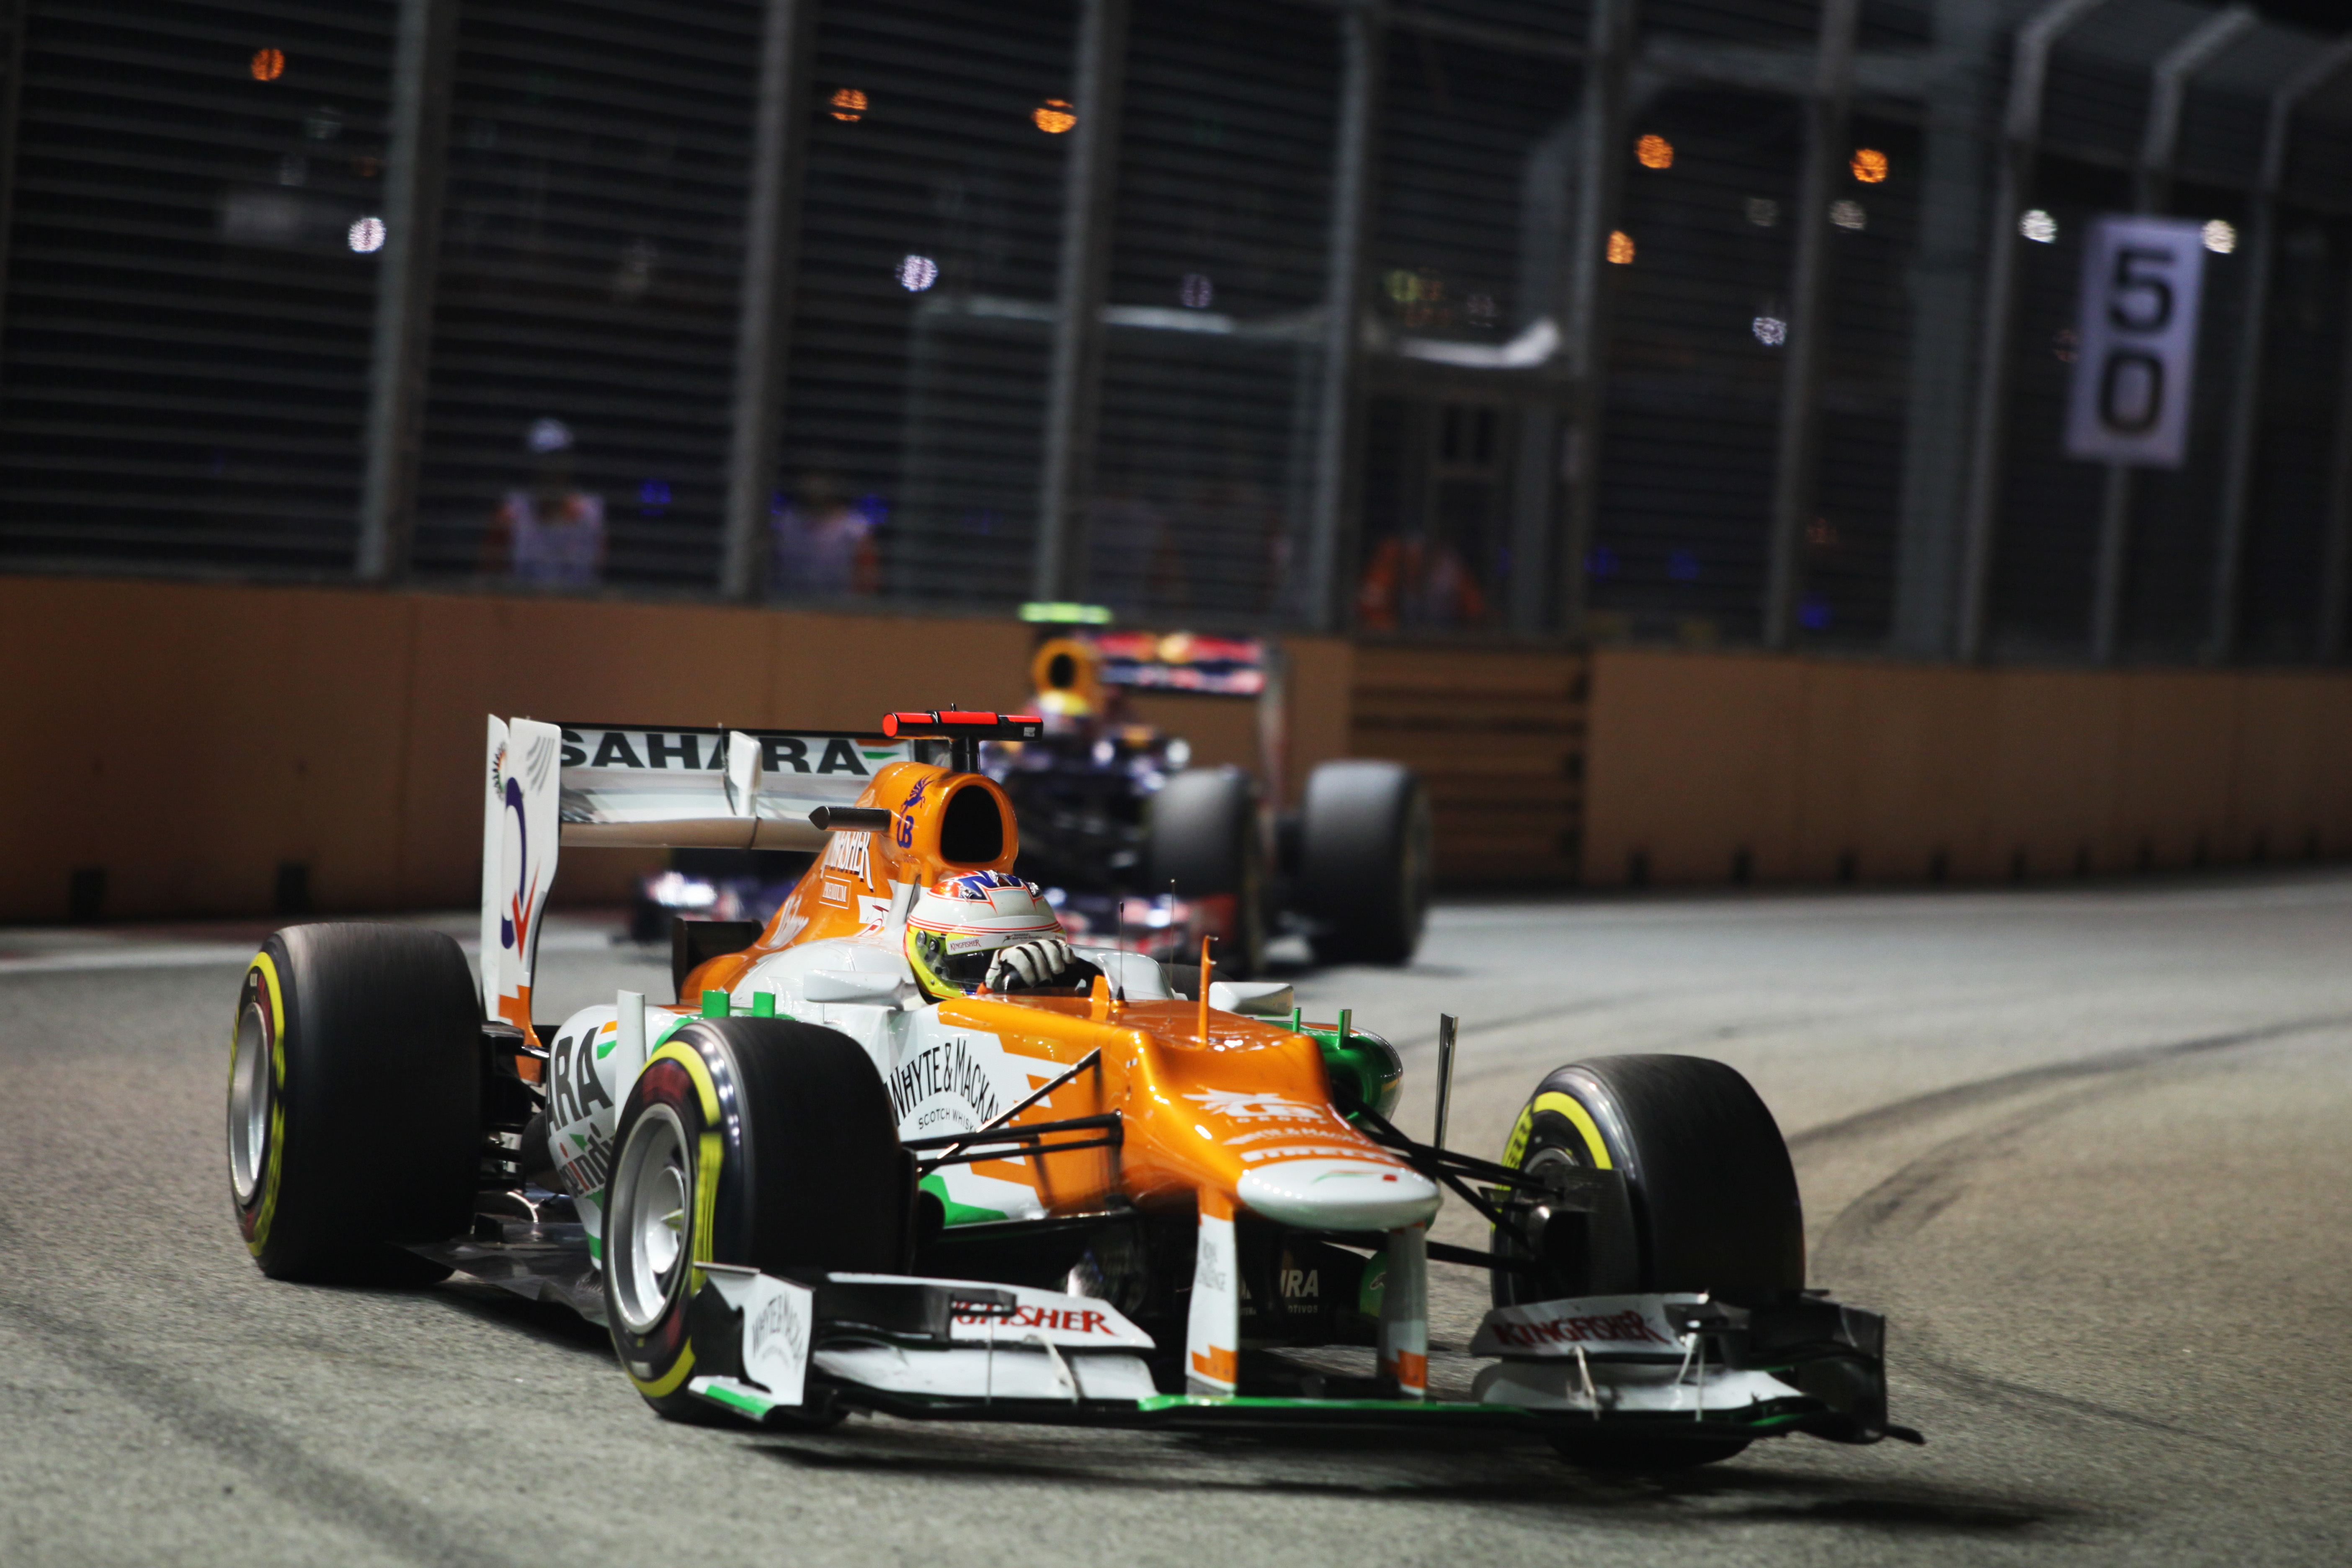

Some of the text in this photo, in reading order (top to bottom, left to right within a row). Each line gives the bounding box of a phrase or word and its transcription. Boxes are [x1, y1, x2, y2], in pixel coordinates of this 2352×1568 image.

[2098, 247, 2174, 436] 50
[950, 939, 981, 951] KINGFISHER
[944, 1042, 953, 1092] &
[918, 1108, 976, 1132] SCOTCH WHISK
